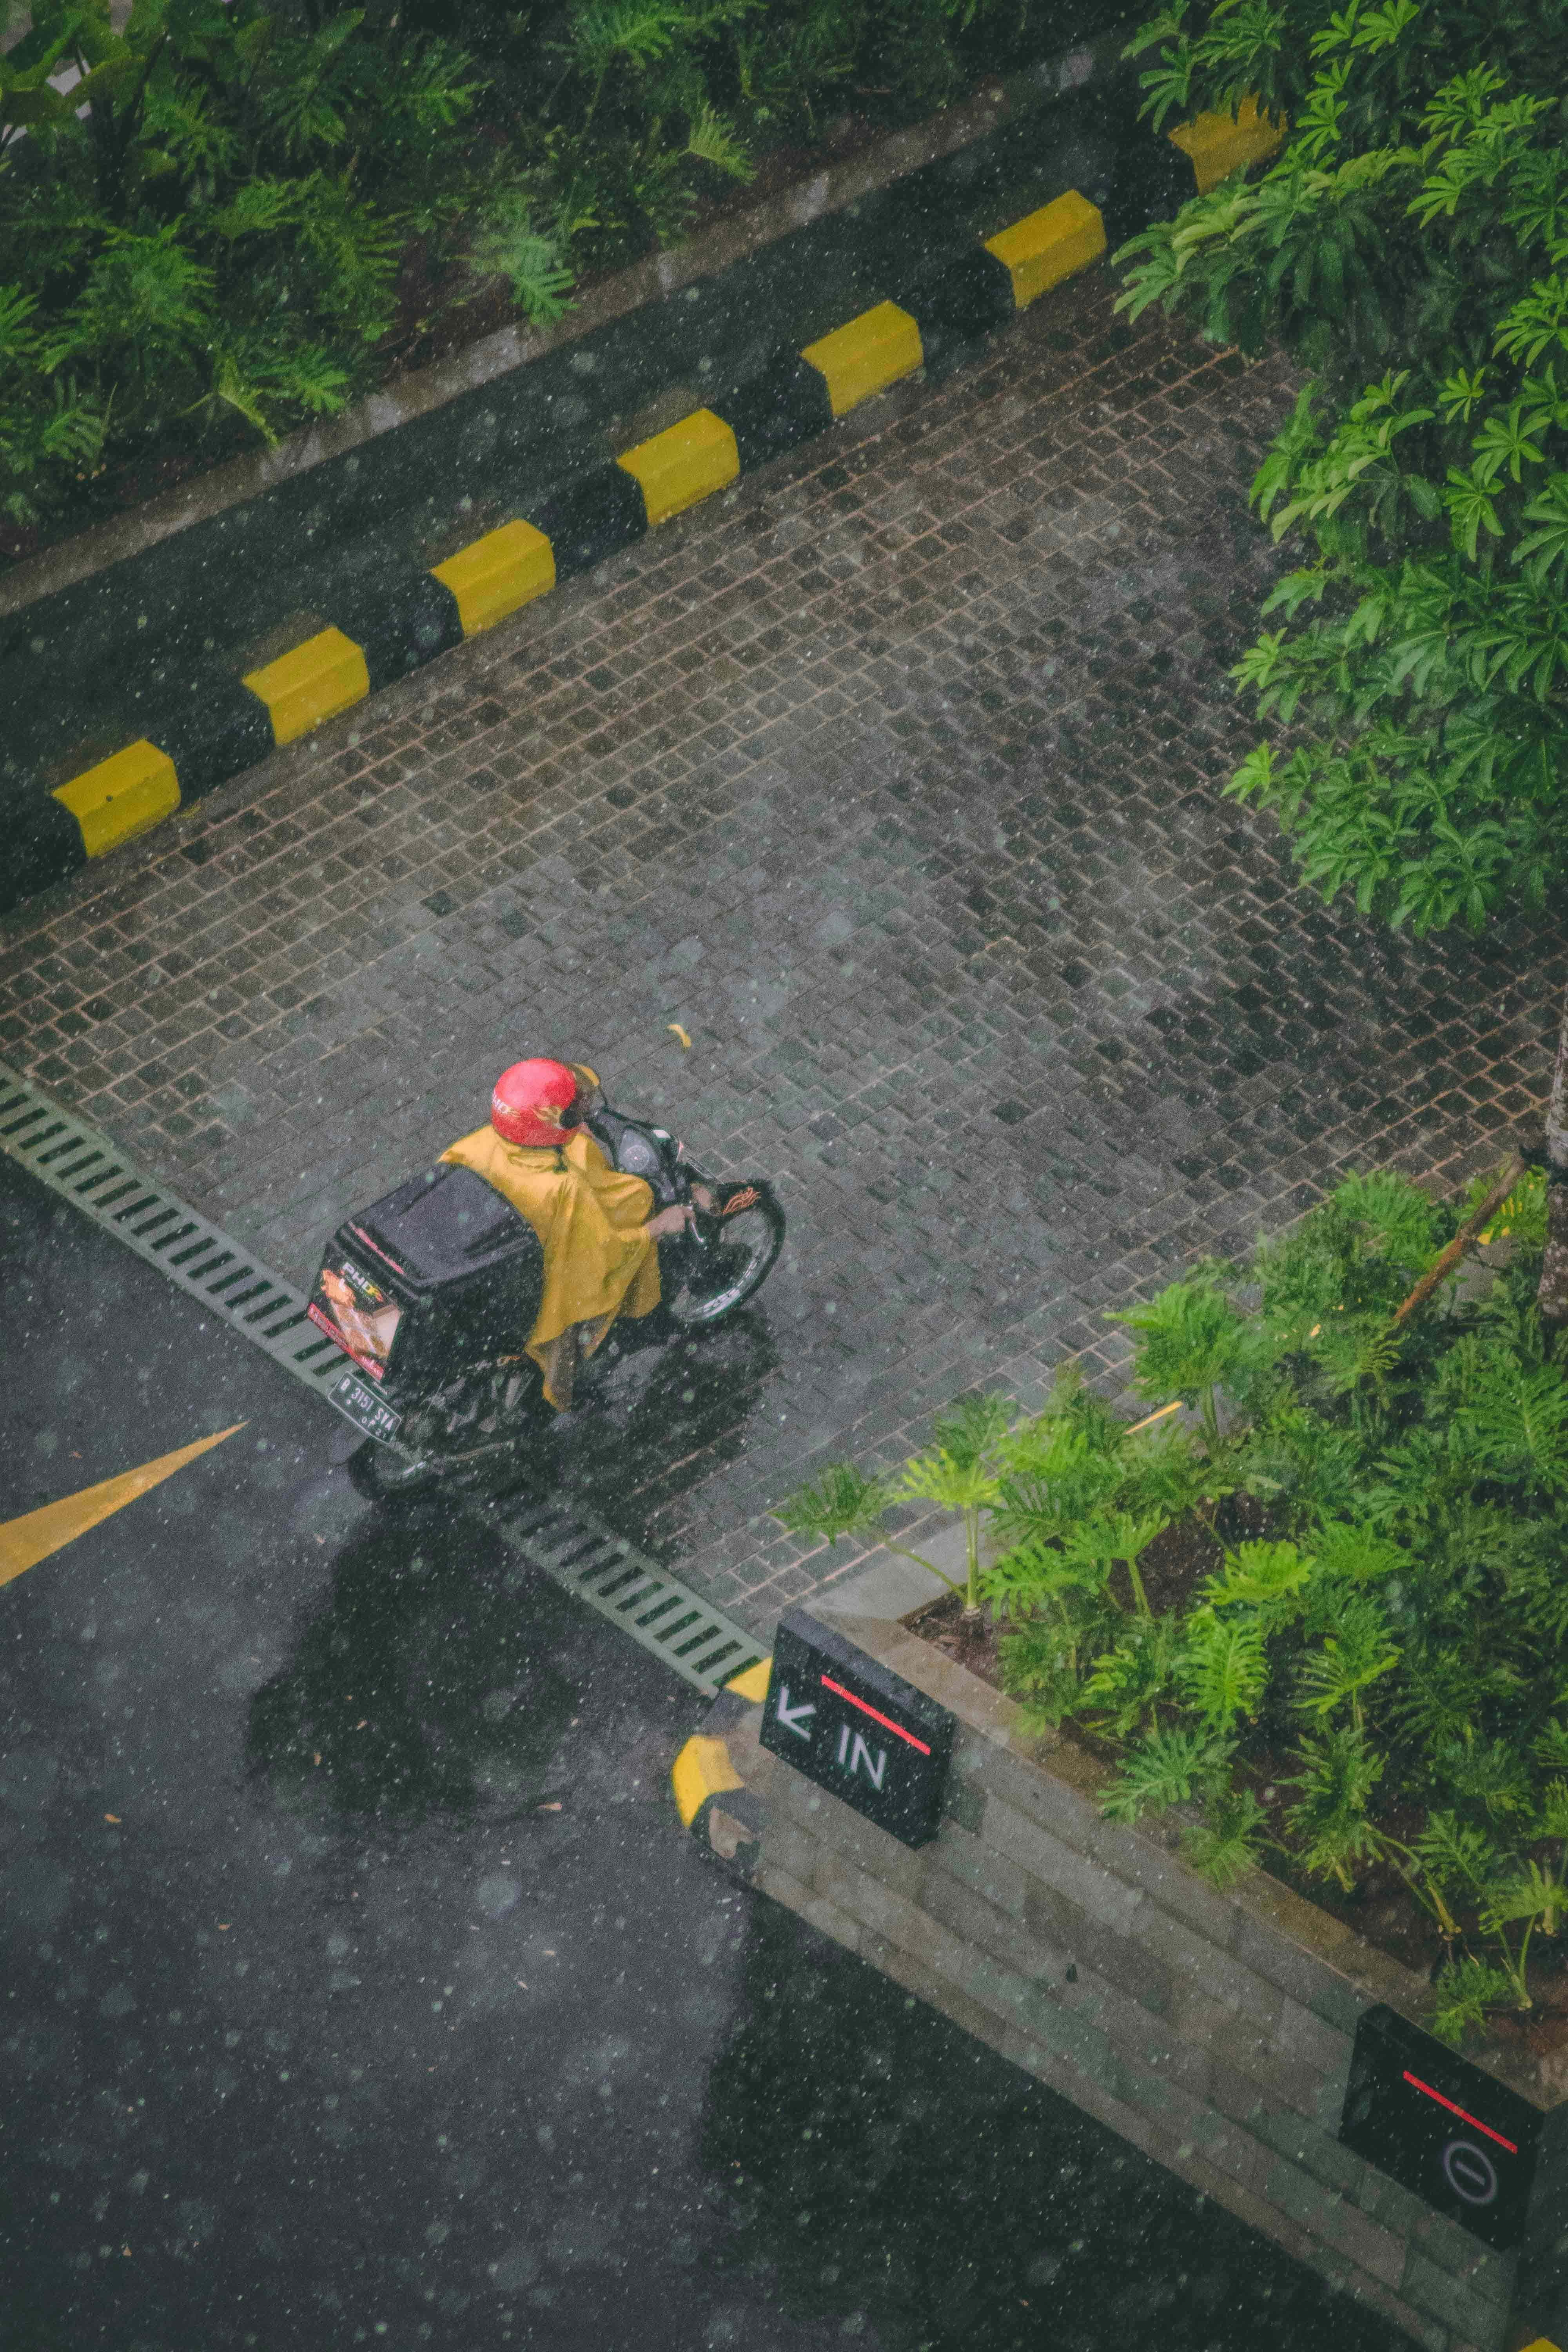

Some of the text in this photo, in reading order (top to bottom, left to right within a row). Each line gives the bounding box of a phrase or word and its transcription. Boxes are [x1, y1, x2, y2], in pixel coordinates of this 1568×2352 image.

[342, 1263, 374, 1295] PHD
[340, 1378, 350, 1390] B
[351, 1388, 374, 1411] 3151
[838, 1724, 886, 1790] IN
